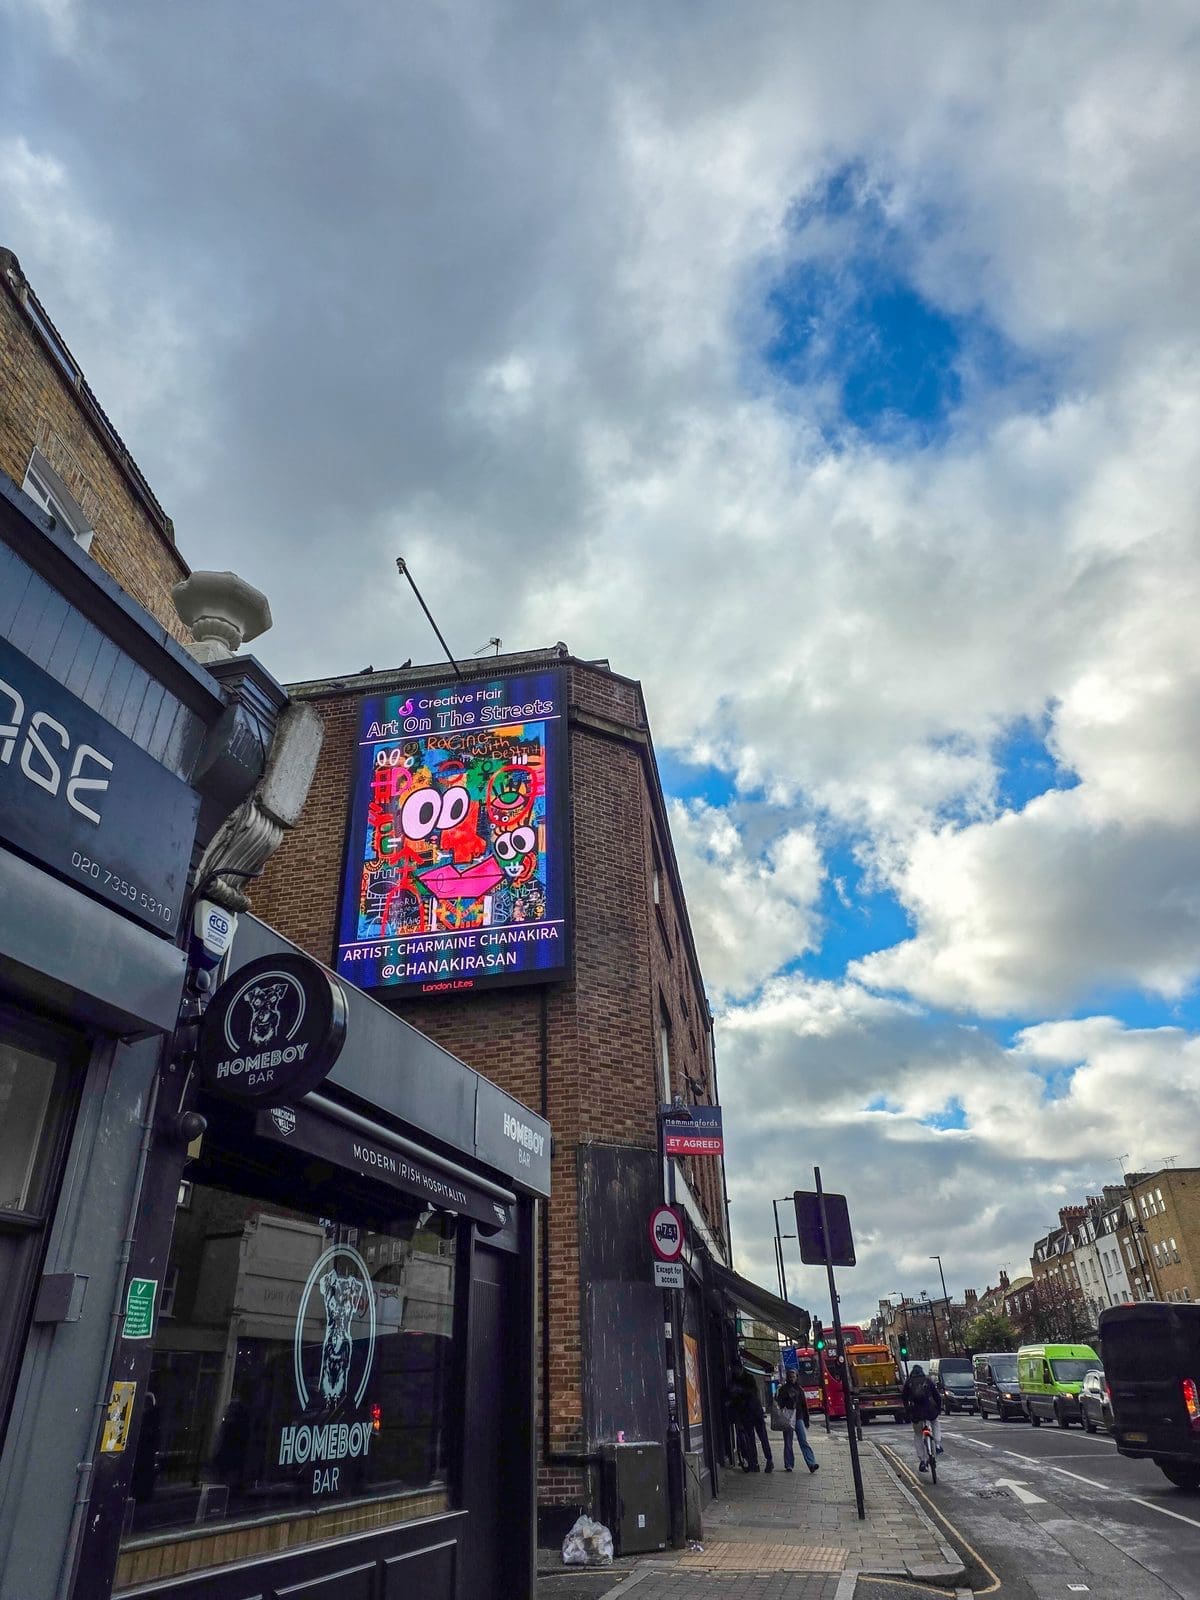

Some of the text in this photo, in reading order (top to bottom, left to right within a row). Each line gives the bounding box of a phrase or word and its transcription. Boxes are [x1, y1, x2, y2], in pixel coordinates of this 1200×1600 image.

[418, 688, 503, 709] Creative Flair
[366, 699, 554, 738] Art On The Streets
[71, 851, 171, 922] 020 7359 5310
[209, 915, 229, 934] ACE
[343, 926, 559, 962] ARTIST: CHARMAINE CHANAKIRA
[381, 951, 517, 979] @CHANAKIRASAN
[422, 982, 452, 992] London
[216, 1042, 309, 1079] HOMEBOY
[248, 1069, 274, 1085] BAR
[503, 1112, 545, 1157] HOMEBOY
[683, 1140, 721, 1149] AGREED
[518, 1148, 531, 1168] BAR
[353, 1143, 467, 1205] MODERN IRISH HOSPITALITY
[656, 1265, 682, 1275] Except for
[661, 1276, 678, 1284] access
[278, 1422, 374, 1466] HOMEBOY
[312, 1467, 340, 1495] BAR
